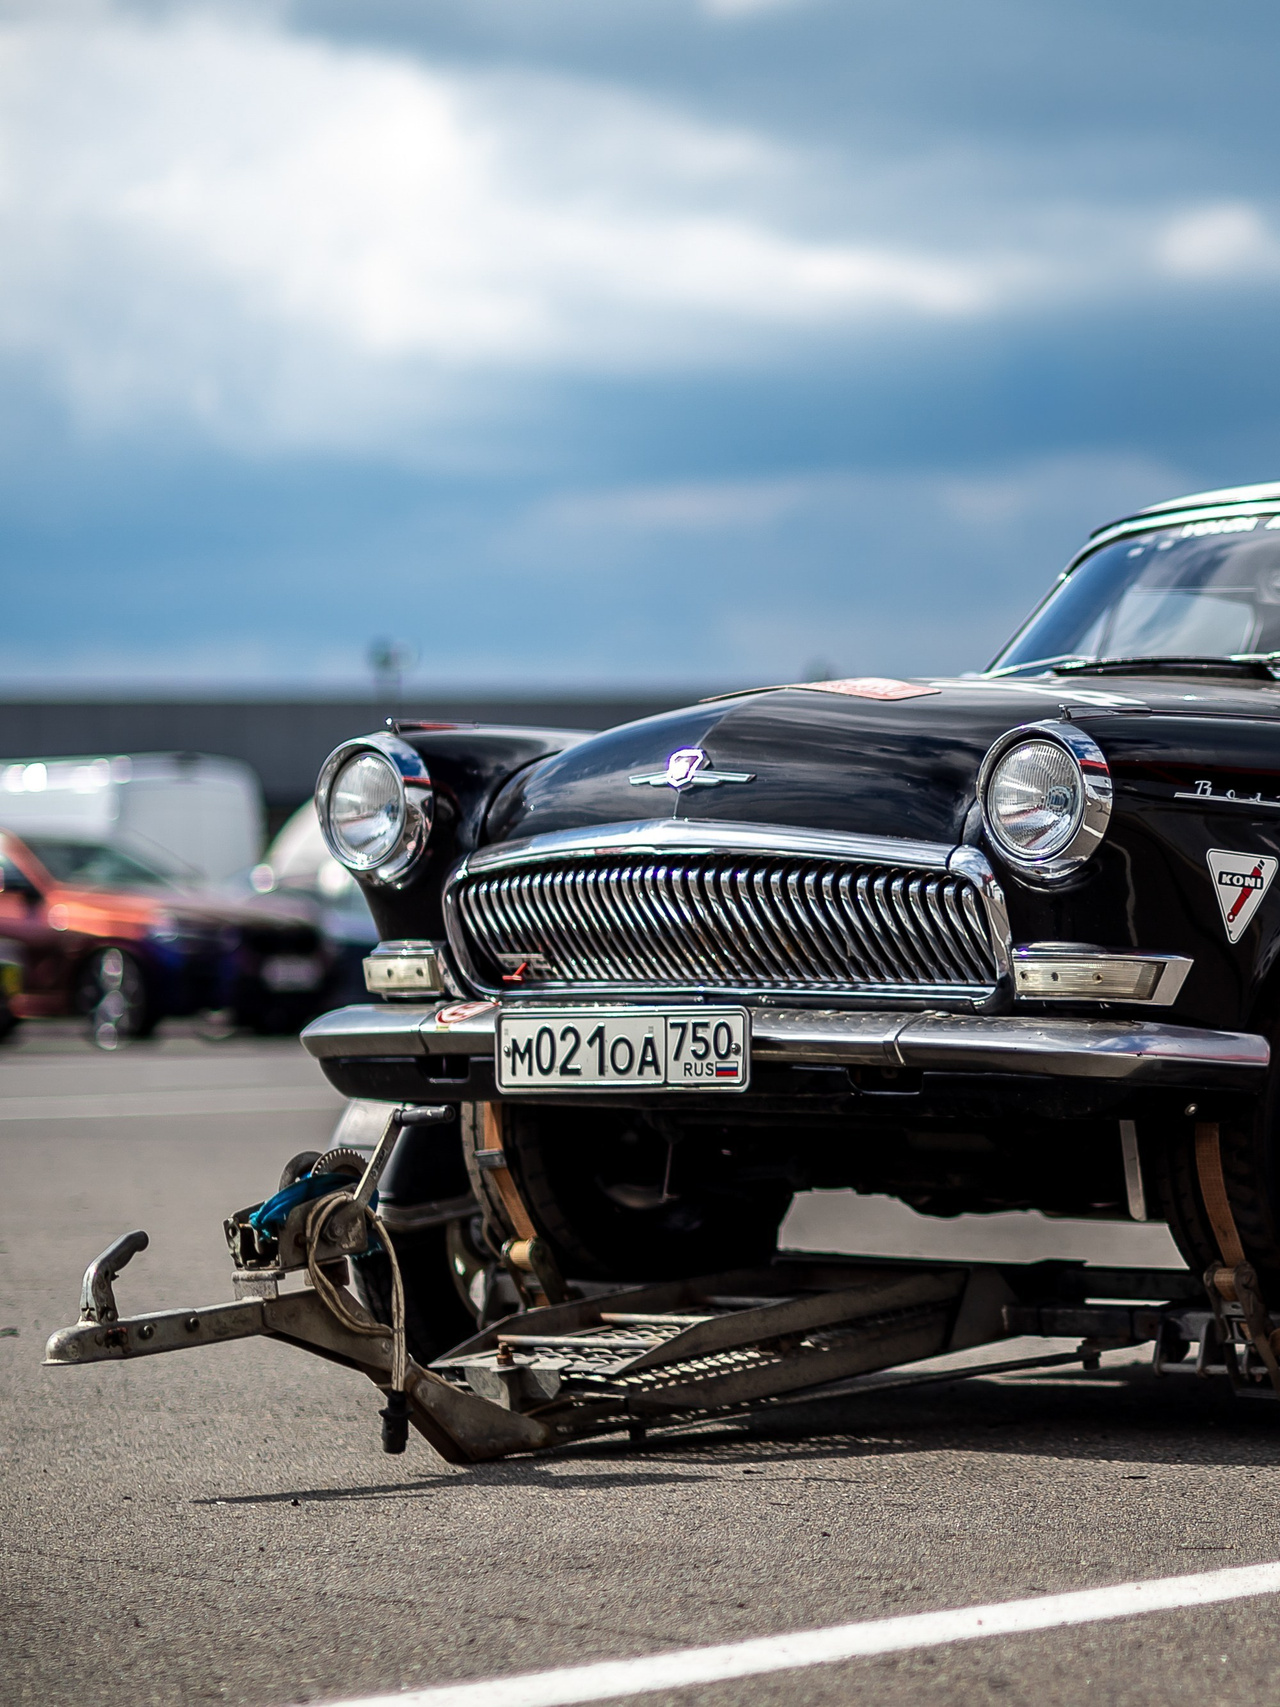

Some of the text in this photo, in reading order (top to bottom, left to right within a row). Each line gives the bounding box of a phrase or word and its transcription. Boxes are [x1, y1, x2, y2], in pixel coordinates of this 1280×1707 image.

[1220, 873, 1263, 889] KONI
[669, 1021, 733, 1062] 750
[683, 1061, 715, 1077] RUS
